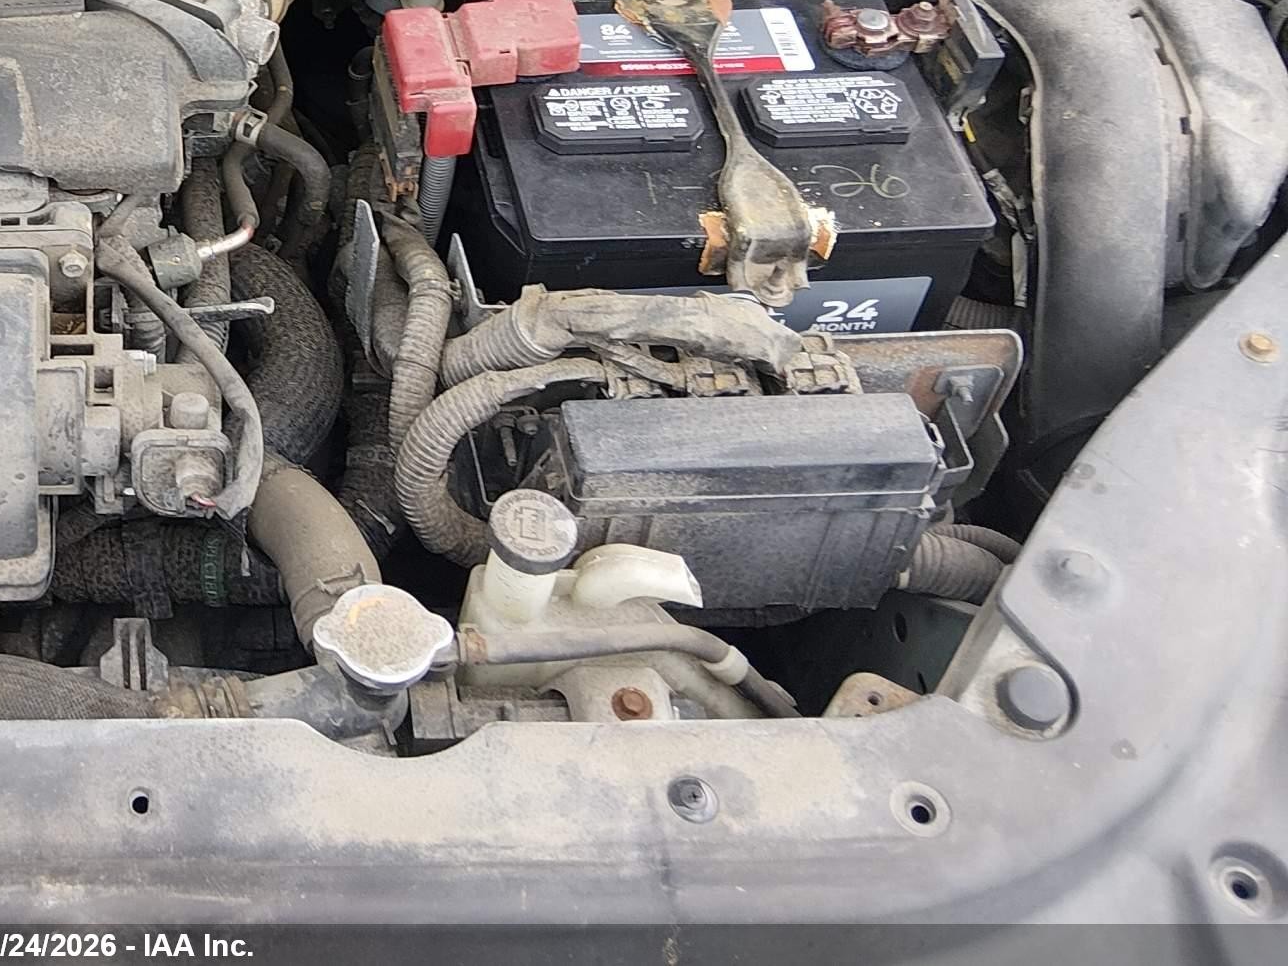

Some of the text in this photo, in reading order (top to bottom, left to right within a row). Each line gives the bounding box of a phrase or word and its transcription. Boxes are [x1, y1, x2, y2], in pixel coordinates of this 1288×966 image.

[600, 24, 631, 36] 84
[560, 87, 612, 97] DANGER
[623, 85, 671, 95] POISON
[815, 298, 880, 323] 24
[812, 320, 877, 332] MONTH
